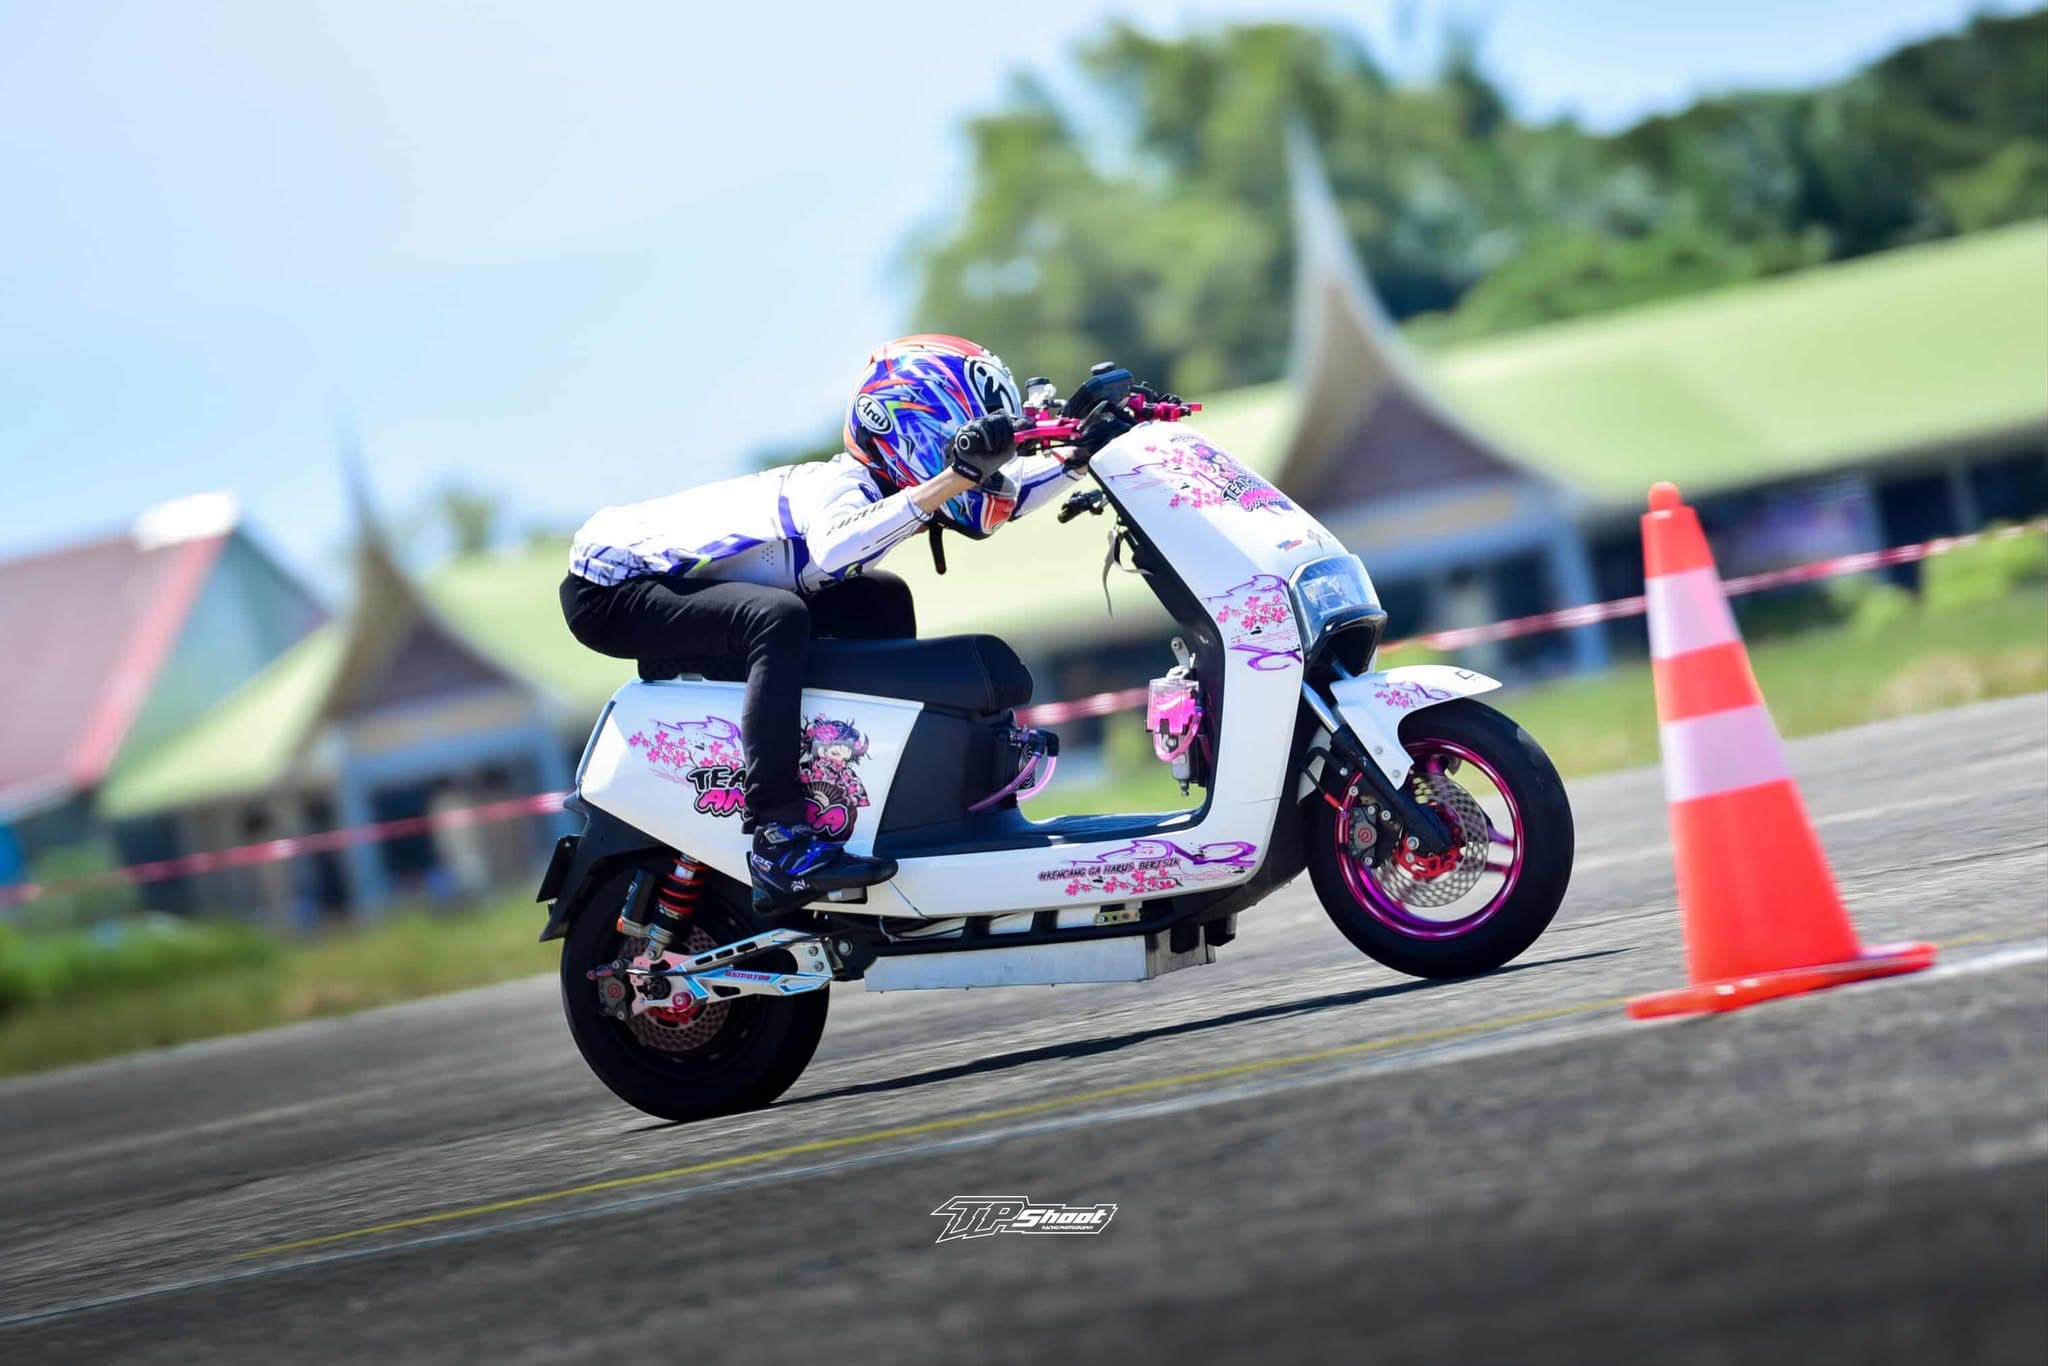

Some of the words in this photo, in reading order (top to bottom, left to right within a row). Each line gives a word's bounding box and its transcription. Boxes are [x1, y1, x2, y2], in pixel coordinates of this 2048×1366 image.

[859, 401, 888, 427] Arai
[688, 766, 749, 792] TEA
[1103, 862, 1135, 875] HARUS
